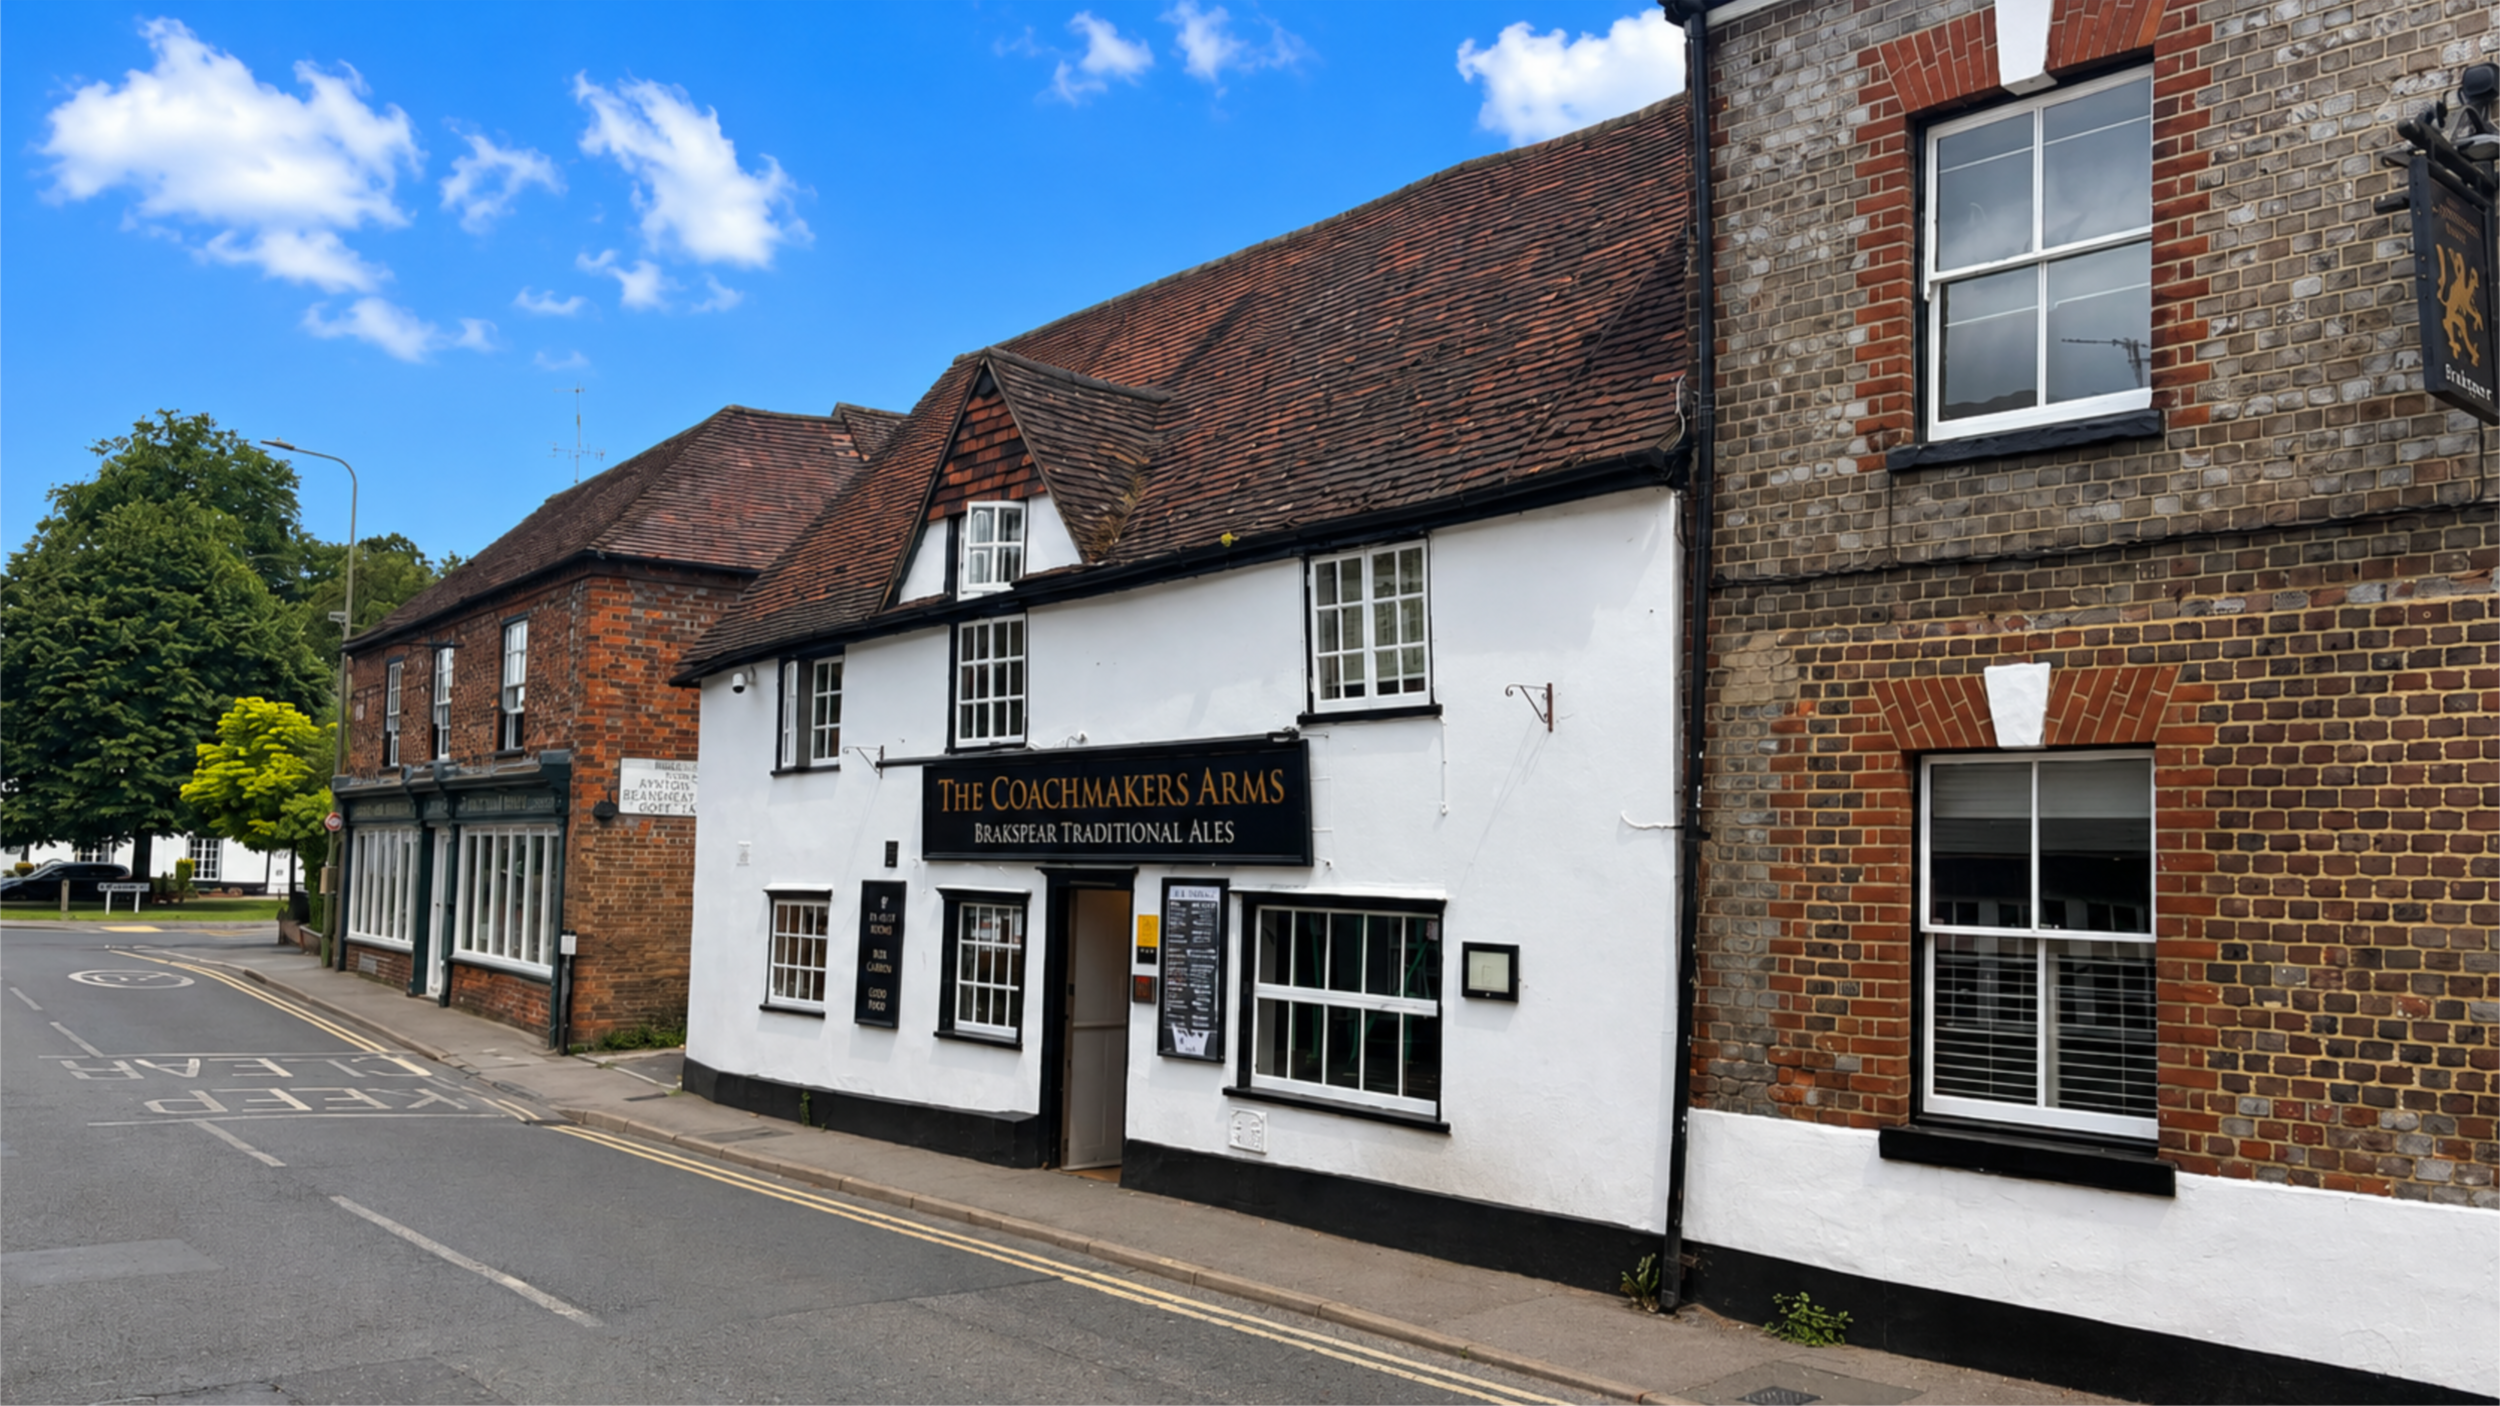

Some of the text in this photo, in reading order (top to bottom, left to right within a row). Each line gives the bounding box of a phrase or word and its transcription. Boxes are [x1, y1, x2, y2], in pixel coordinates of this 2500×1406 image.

[938, 767, 1285, 812] THE COACHMAKERS ARMS
[975, 819, 1235, 844] BRAKSPEAR TRADITIONAL ALES
[61, 1057, 432, 1080] CLEAR
[144, 1088, 468, 1114] KEEP
